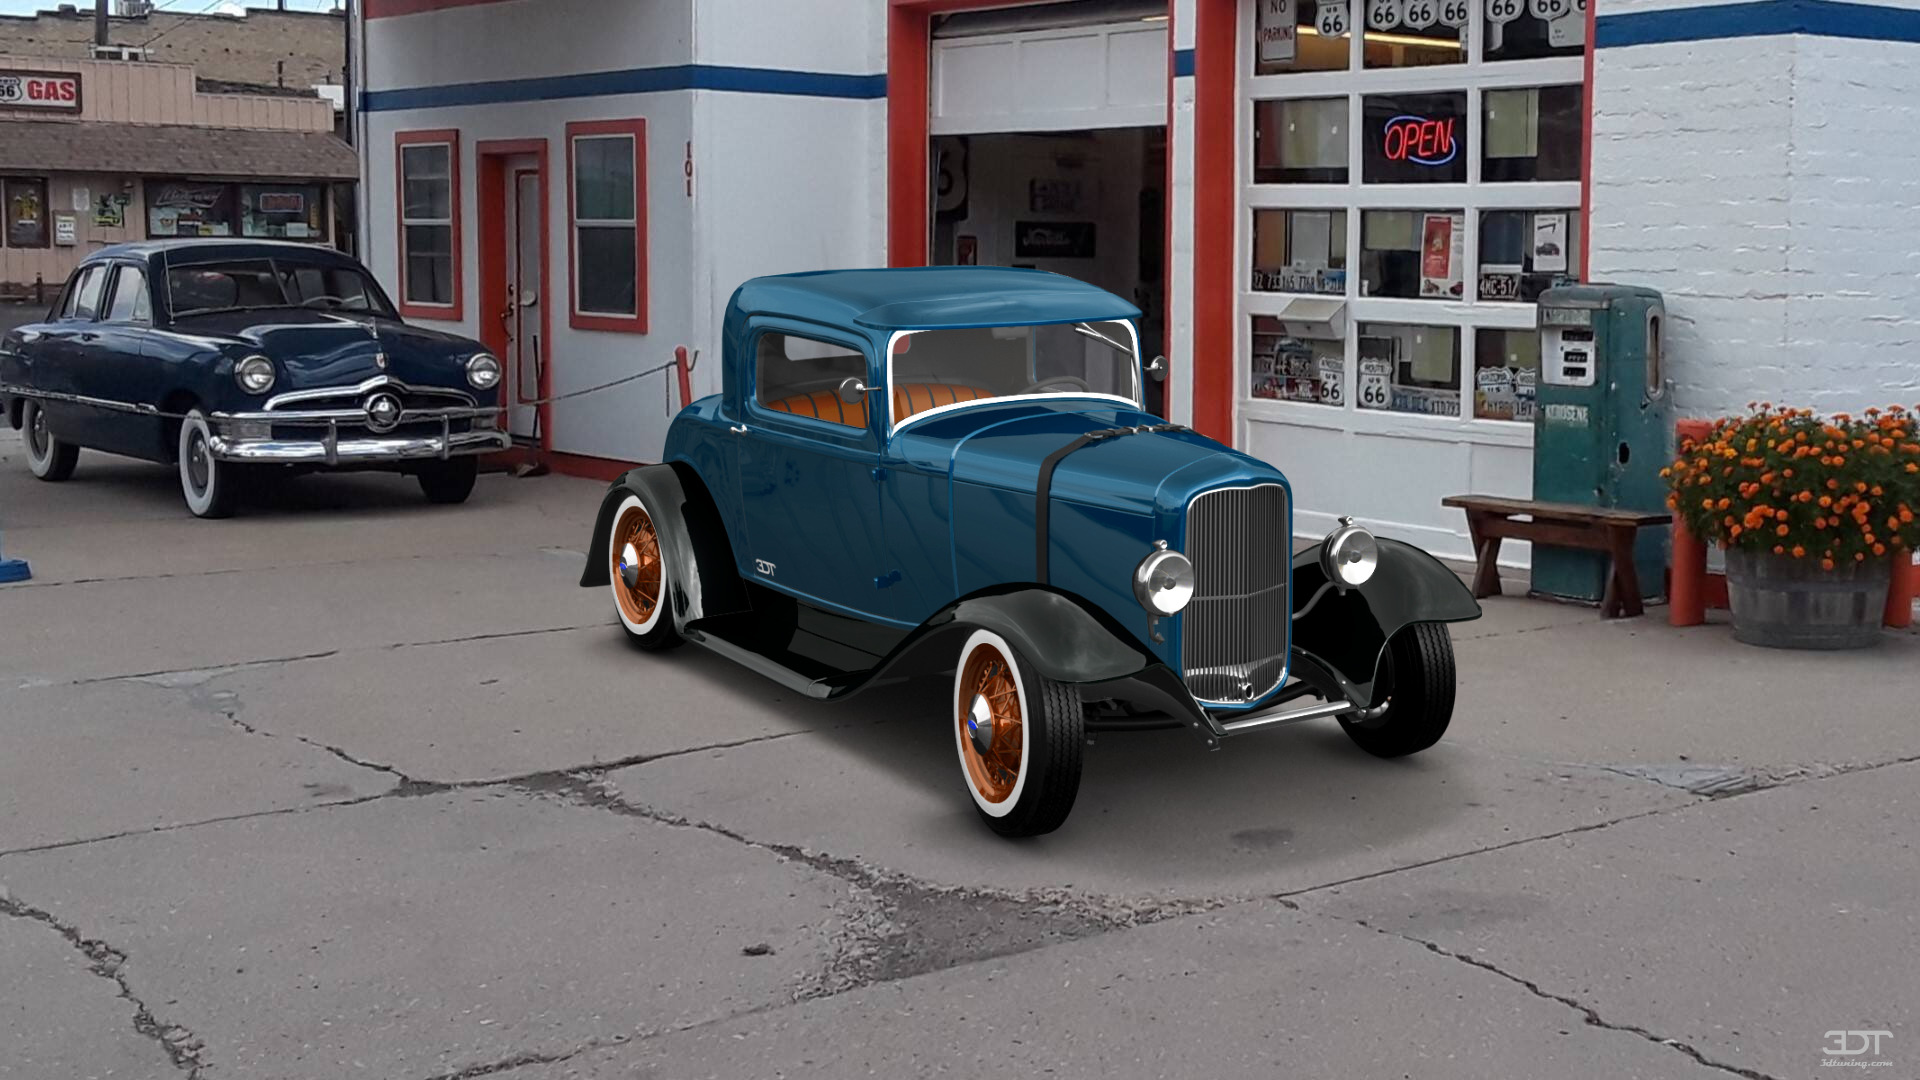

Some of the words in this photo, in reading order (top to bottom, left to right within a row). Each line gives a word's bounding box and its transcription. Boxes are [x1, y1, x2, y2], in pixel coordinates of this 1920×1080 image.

[1271, 0, 1287, 13] NO
[1373, 6, 1395, 24] 66
[1409, 3, 1431, 22] 66
[1445, 2, 1467, 20] 66
[1492, 0, 1516, 16] 66
[1263, 25, 1293, 42] PARKING
[1322, 15, 1343, 34] 66
[27, 80, 76, 101] GAS
[1385, 119, 1454, 160] OPEN
[1364, 363, 1385, 372] ROUTE
[1321, 382, 1340, 400] 66
[1364, 386, 1385, 404] 66
[1545, 404, 1588, 421] KEROSENE
[755, 558, 776, 577] 3DT
